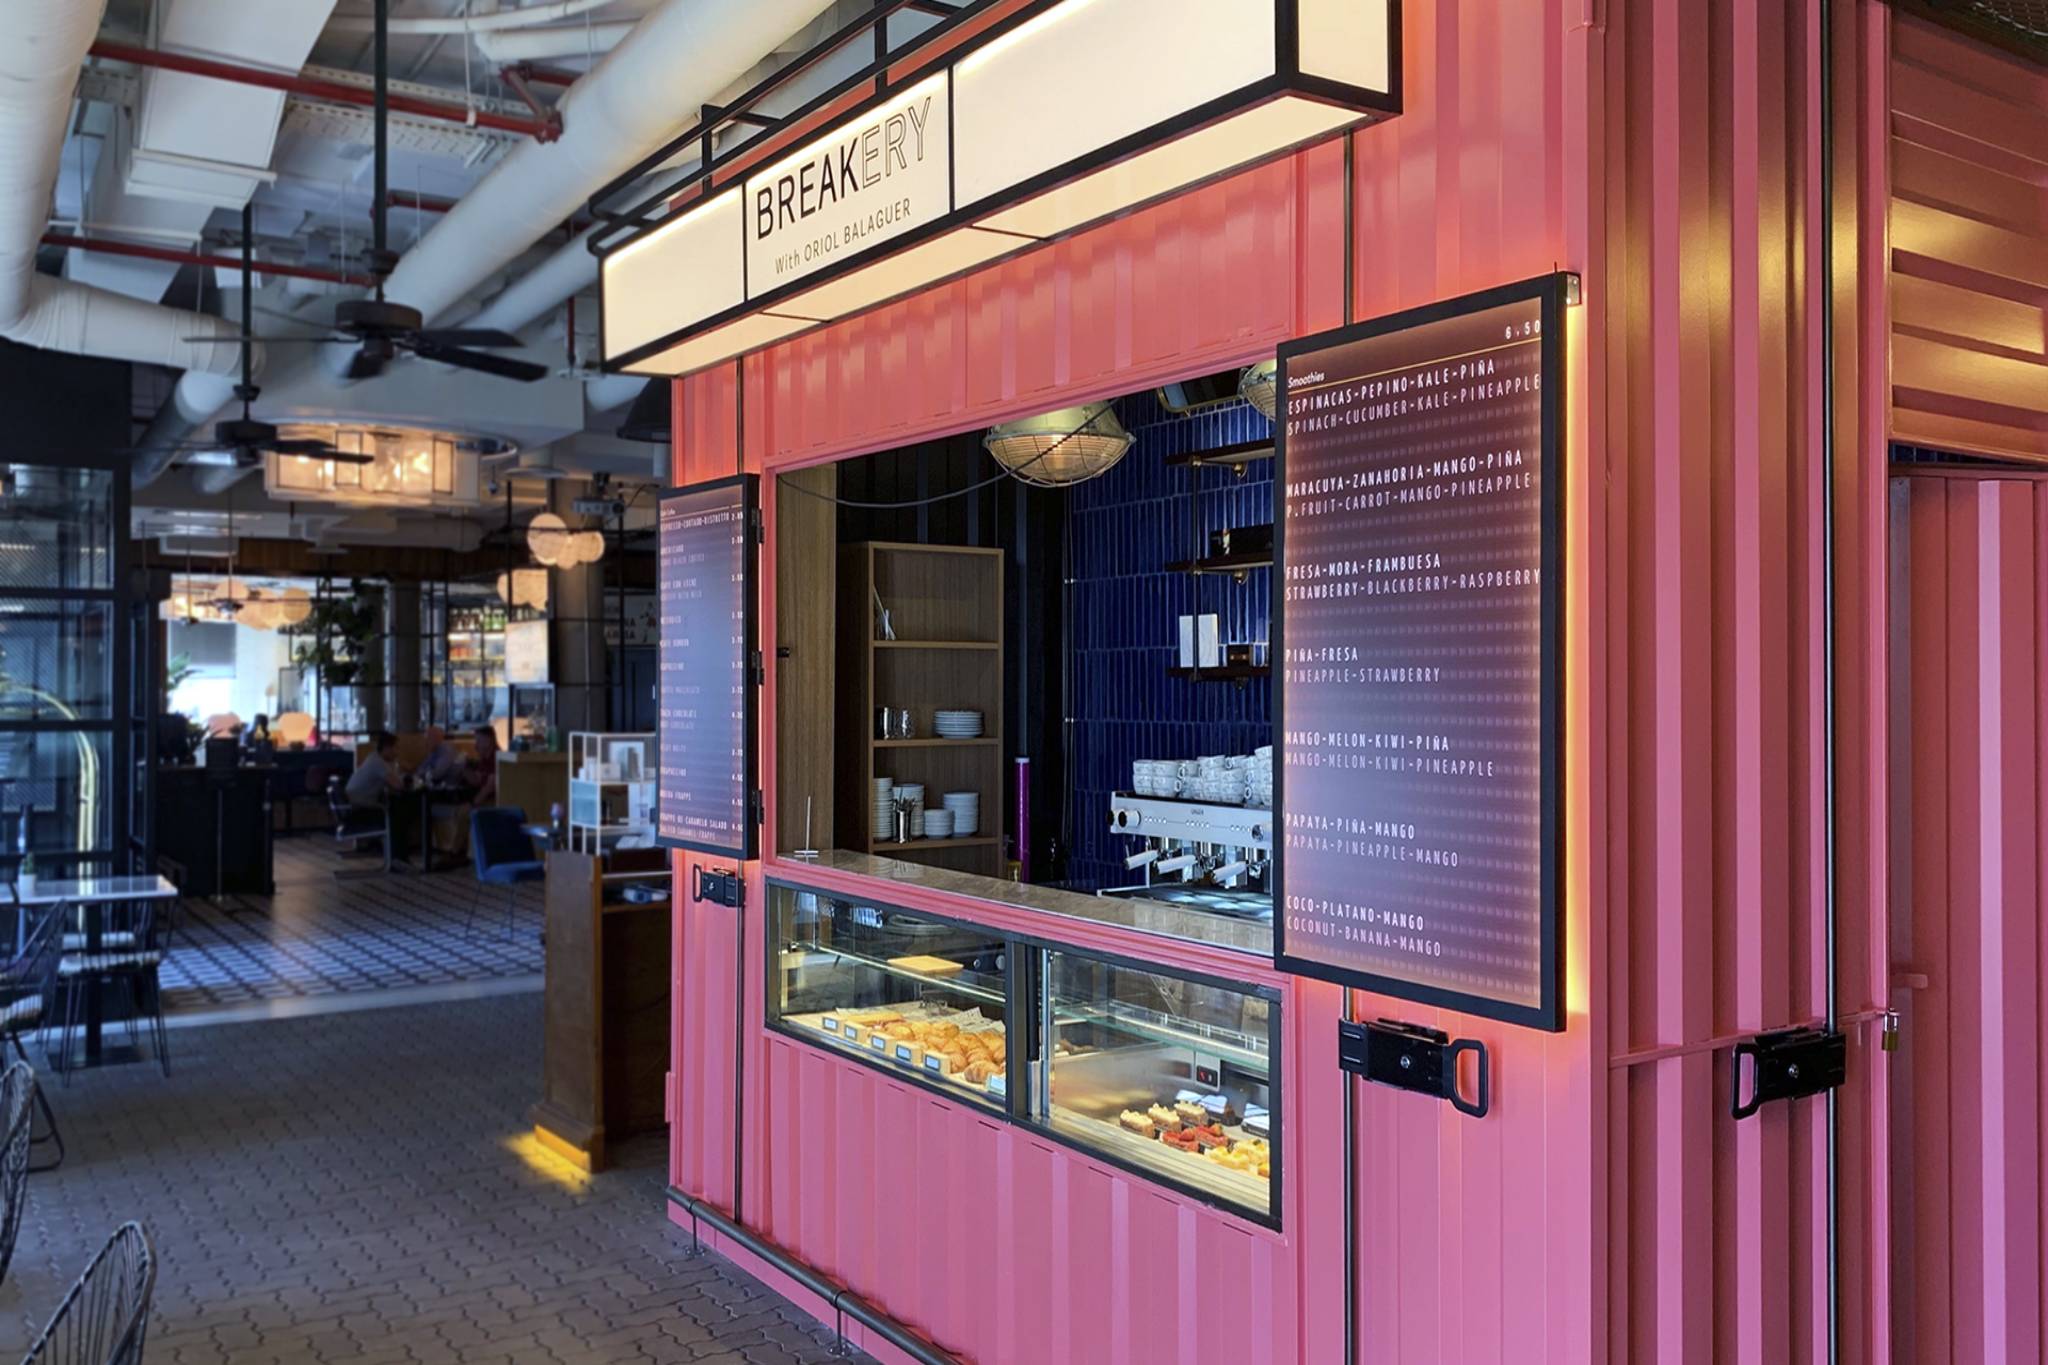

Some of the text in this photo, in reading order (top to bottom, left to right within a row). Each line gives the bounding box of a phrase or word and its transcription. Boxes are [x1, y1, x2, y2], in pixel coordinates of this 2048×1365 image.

[757, 96, 932, 239] BREAKERY
[775, 197, 911, 275] With ORIOL BALAGUER
[1287, 371, 1325, 388] Smoothies
[1287, 374, 1541, 436] SPINACH-CUCUMBER-KALE-PINEAPPLE
[1286, 552, 1441, 581] FRESA-MORA-FRAMBUESA
[1285, 567, 1541, 602] STRAWBERRY-BLACKBERRY-RASPBERRY
[1285, 667, 1441, 684] PINEAPPLE-STRAWBERRY
